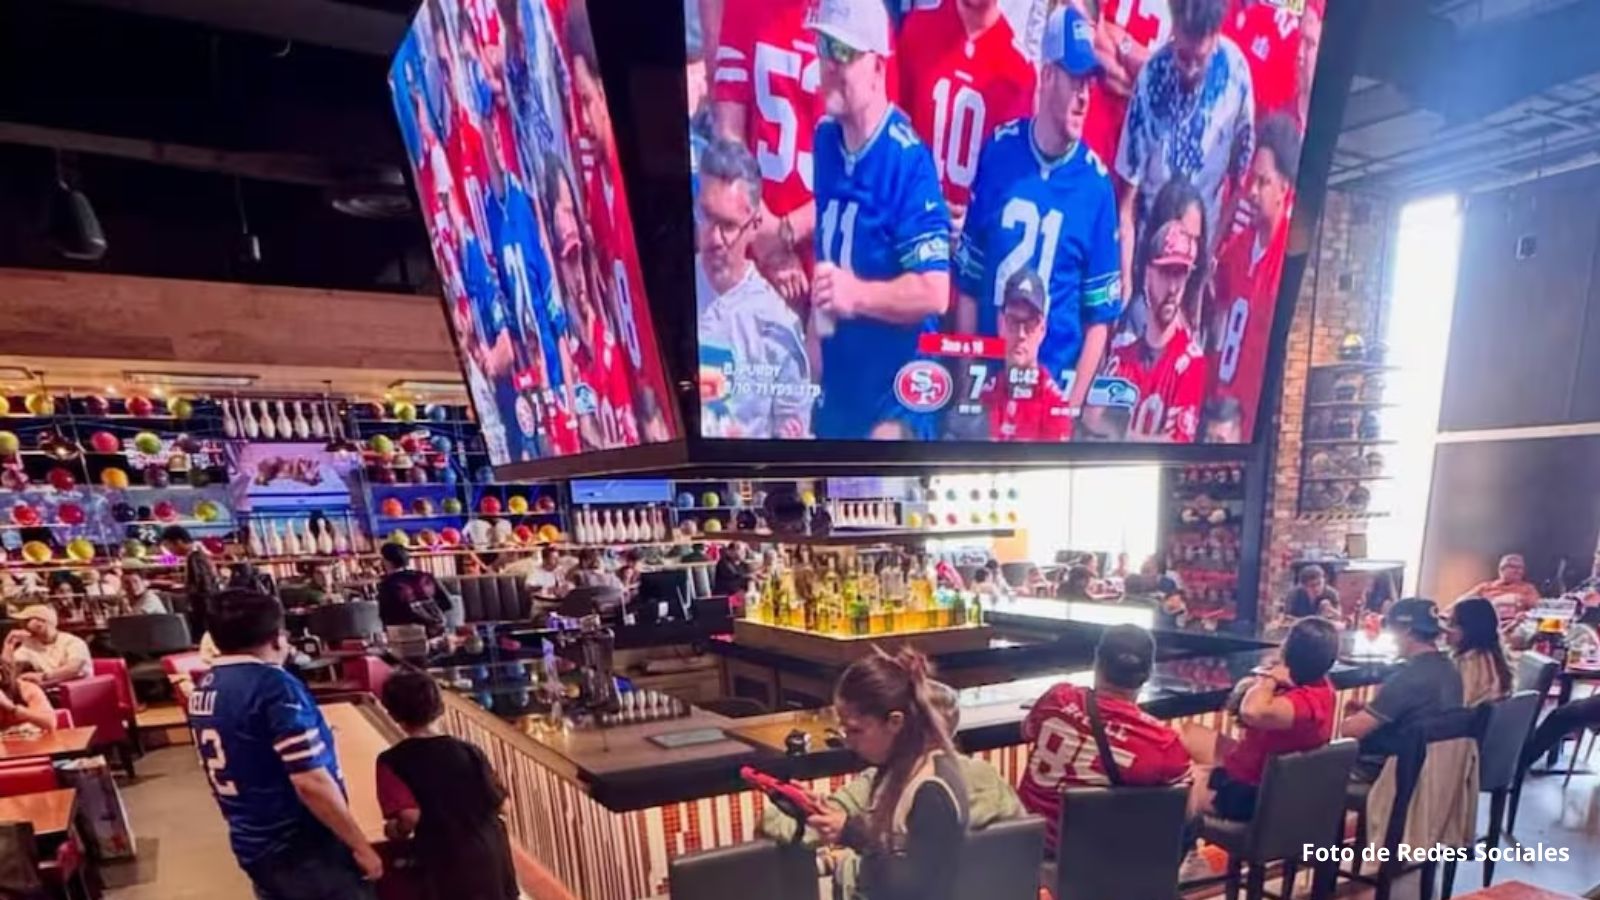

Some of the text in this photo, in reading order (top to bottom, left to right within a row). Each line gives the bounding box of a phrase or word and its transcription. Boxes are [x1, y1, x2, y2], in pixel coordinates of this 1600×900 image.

[931, 76, 986, 188] 10
[994, 197, 1063, 306] 21
[969, 365, 987, 399] 7
[1218, 298, 1249, 383] 8
